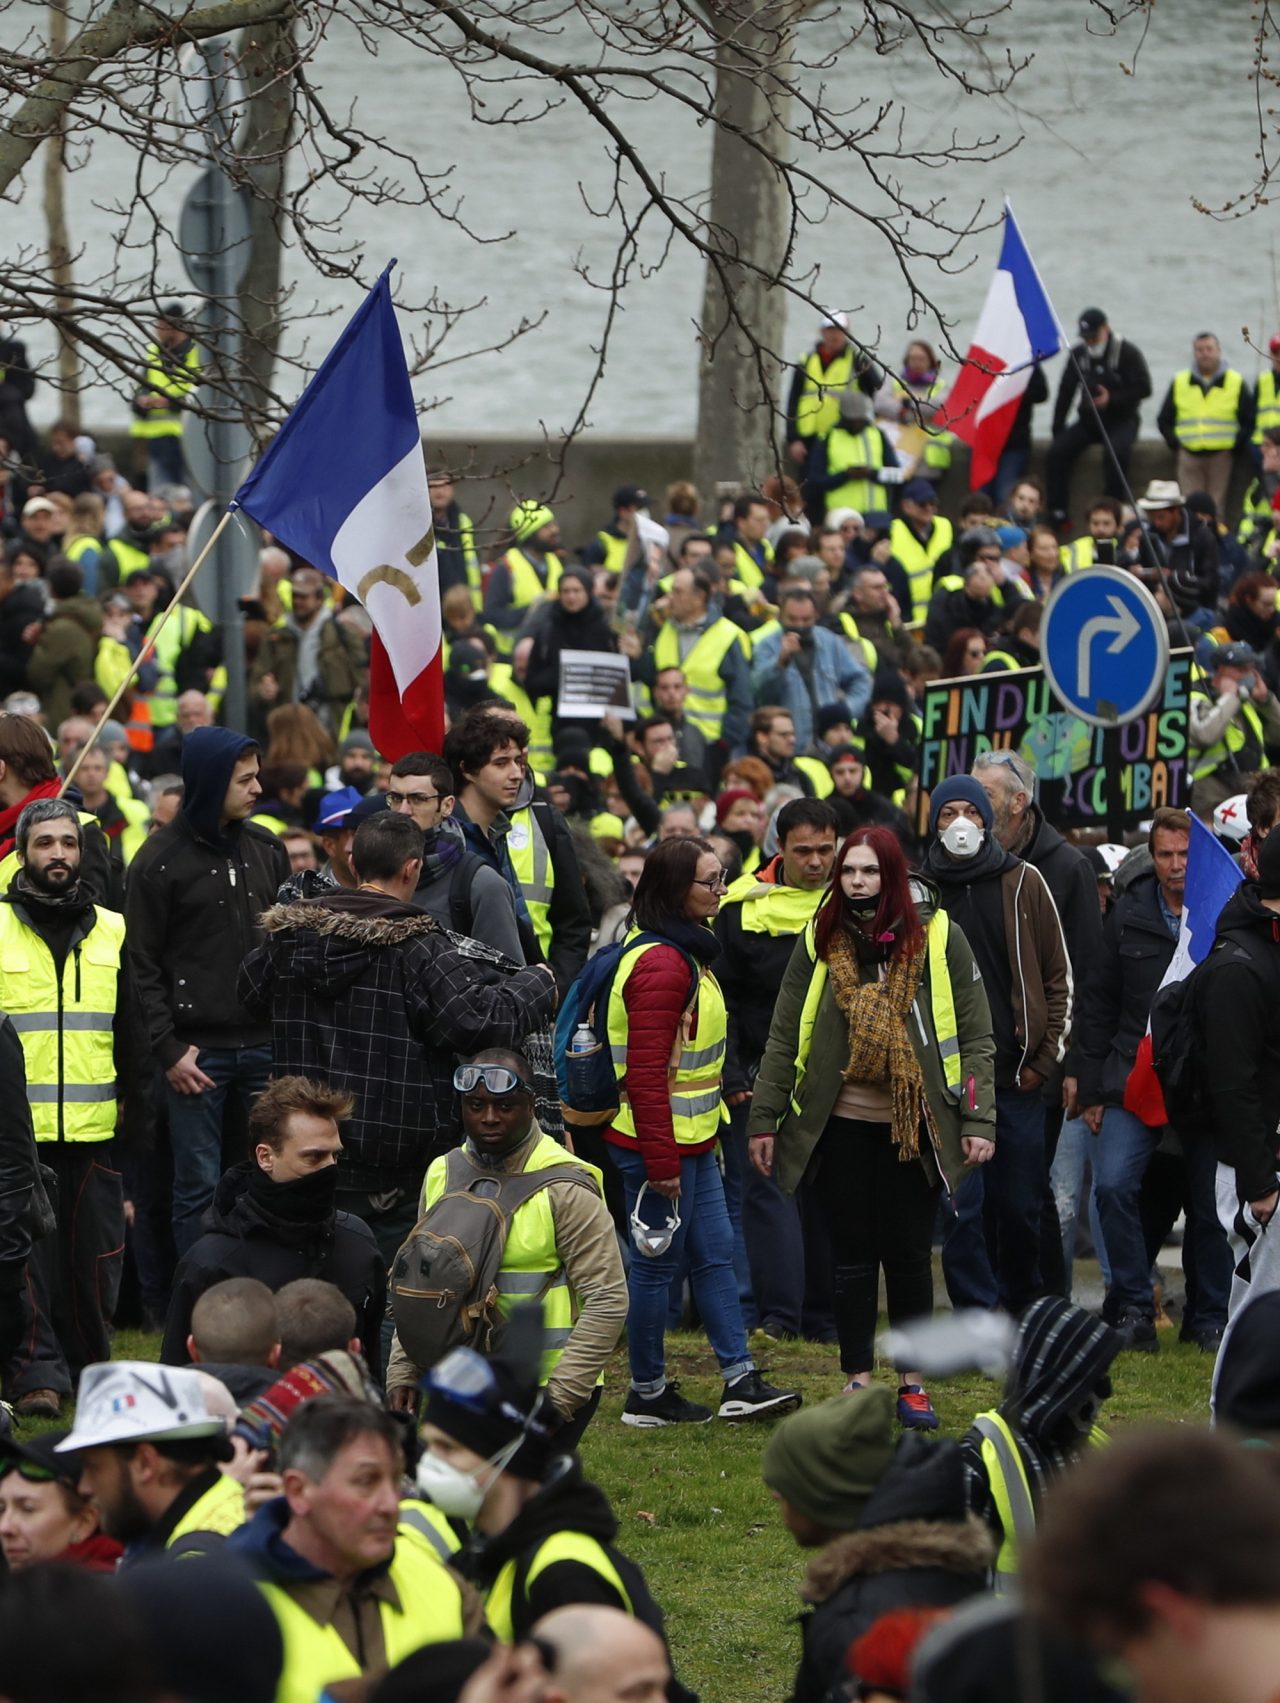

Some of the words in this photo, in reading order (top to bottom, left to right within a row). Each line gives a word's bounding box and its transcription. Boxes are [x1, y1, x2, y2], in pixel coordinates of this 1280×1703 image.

[924, 685, 989, 739] FIN
[996, 679, 1051, 729] DU
[922, 737, 968, 788] FIN
[1095, 710, 1187, 765] OIS
